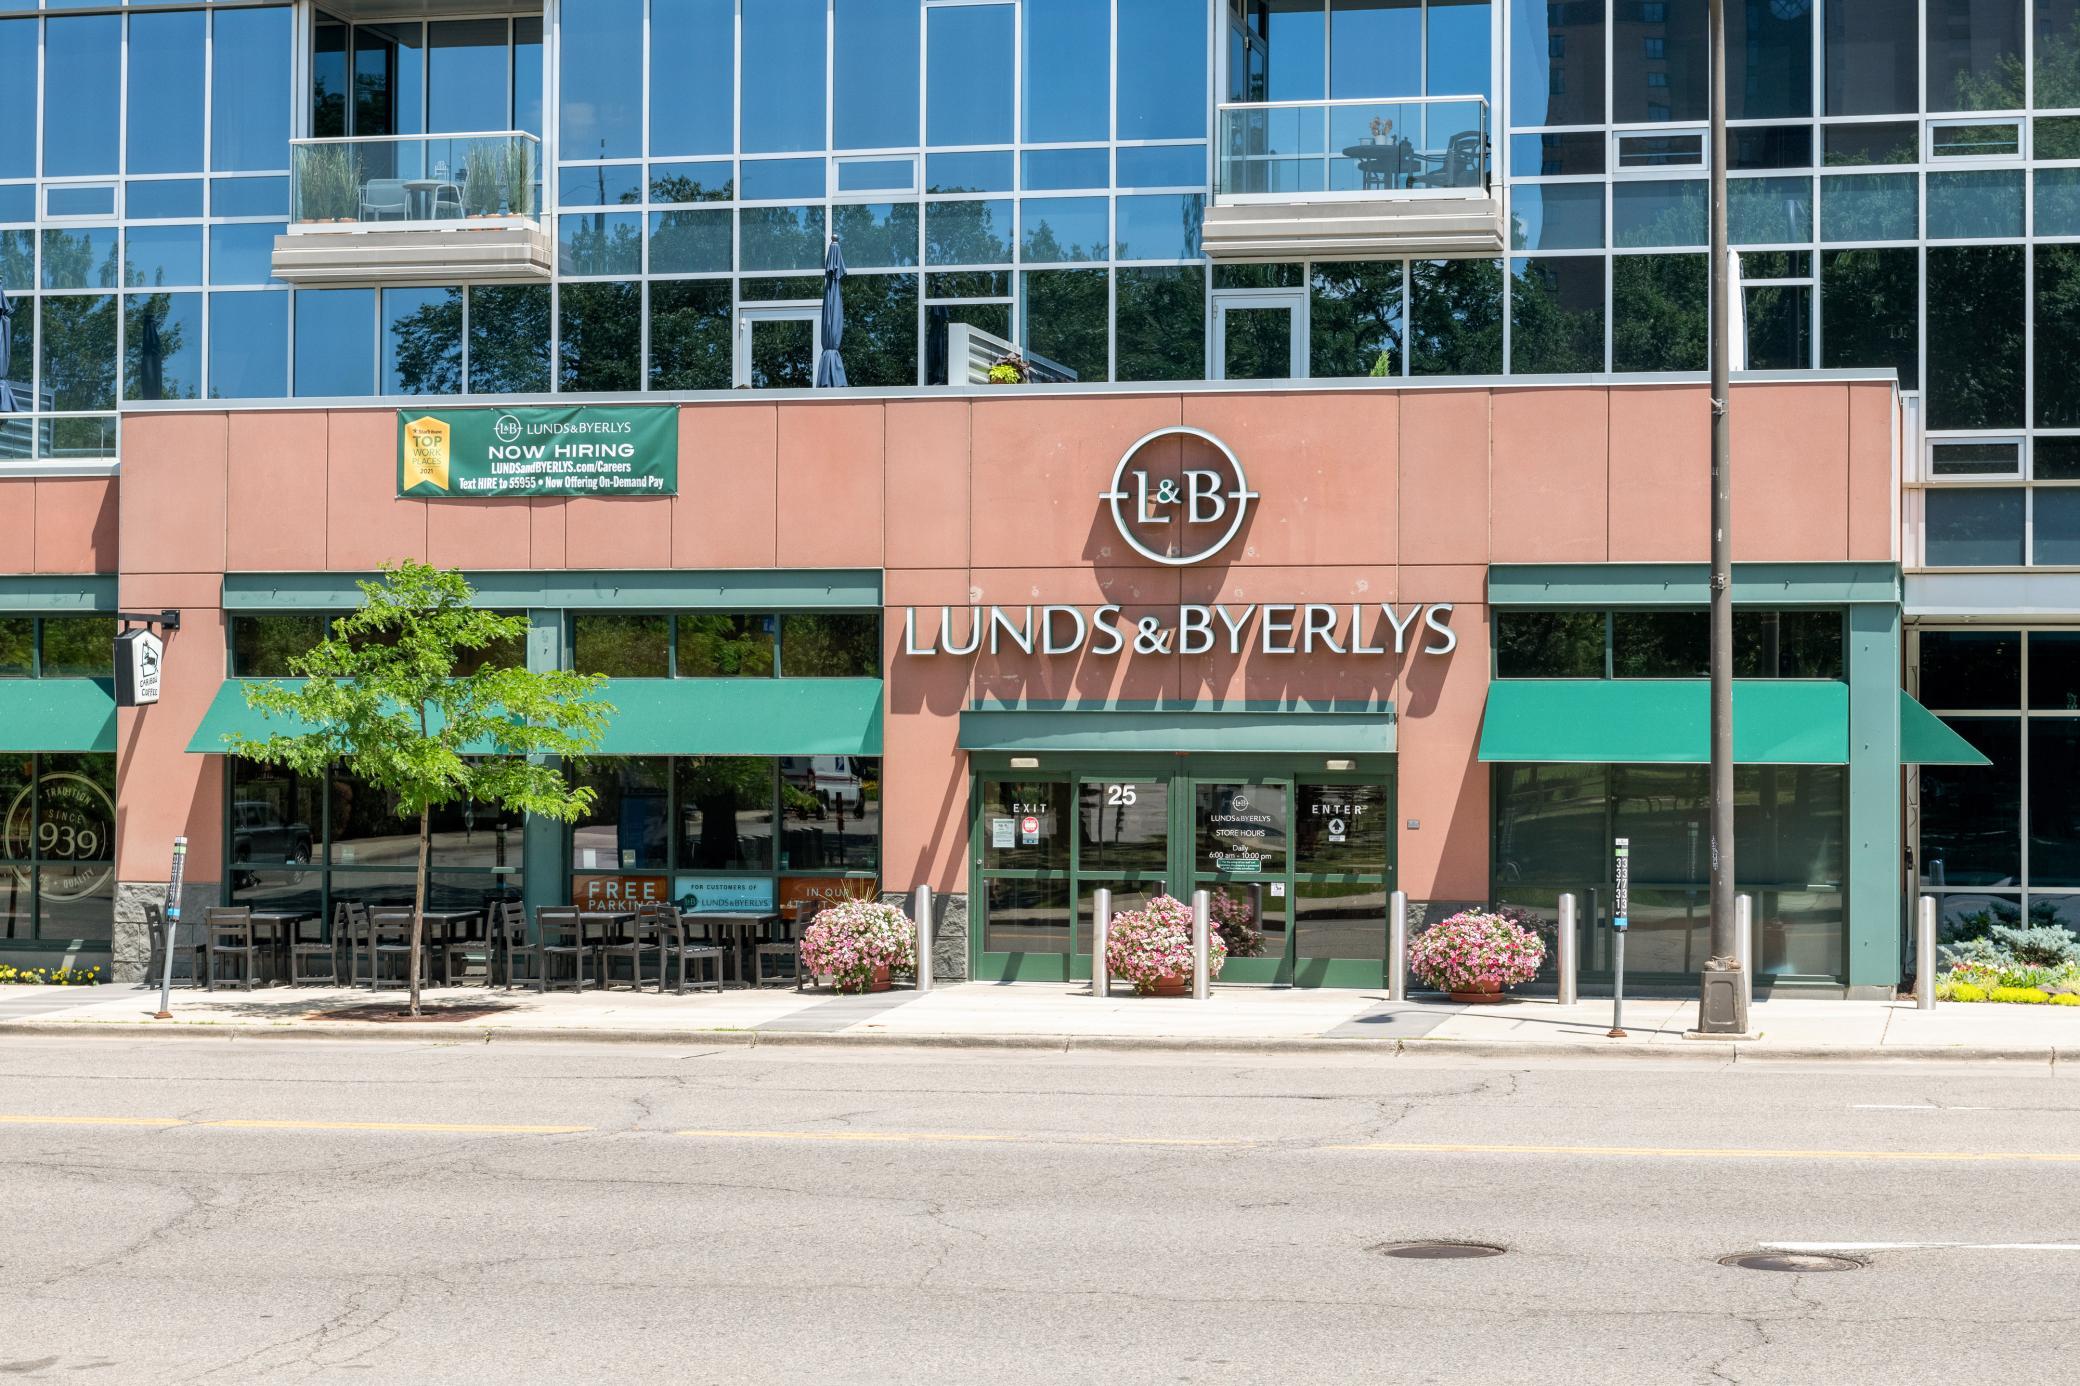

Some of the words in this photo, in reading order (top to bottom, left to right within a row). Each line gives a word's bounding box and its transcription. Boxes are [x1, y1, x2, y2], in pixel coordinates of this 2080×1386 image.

[527, 421, 632, 435] LUNDS&BYERLYS
[412, 435, 442, 447] TOP
[413, 449, 441, 457] WORK
[488, 445, 546, 459] NOW
[554, 443, 635, 458] HIRING
[412, 457, 441, 465] PLACES
[491, 461, 632, 475] LUNDSandBYERLYS.com/Careers
[459, 477, 477, 490] Text
[477, 477, 498, 489] HIRE
[499, 479, 508, 489] to
[509, 477, 537, 489] 55955
[545, 477, 563, 488] Now
[564, 476, 598, 490] Offering
[599, 476, 647, 488] On-Demand
[648, 476, 664, 490] Pay
[1131, 469, 1228, 525] L&B
[905, 602, 1458, 656] LUNDS&BYERLYS
[142, 688, 158, 696] COFFEE
[45, 786, 92, 805] TRADITION
[1108, 784, 1137, 806] 25
[1013, 803, 1047, 813] EXIT
[1312, 804, 1361, 815] ENTER
[48, 808, 85, 824] SINCE
[1210, 814, 1272, 822] LUNDS&BYERLYS
[1216, 829, 1239, 837] STORE
[1240, 829, 1266, 837] HOURS
[28, 822, 98, 859] 939
[1208, 851, 1224, 859] 6:00
[1242, 852, 1260, 860] 10:00
[1232, 844, 1249, 853] Daily
[63, 868, 95, 889] QUALITY
[588, 881, 656, 900] FREE
[806, 888, 820, 897] IN
